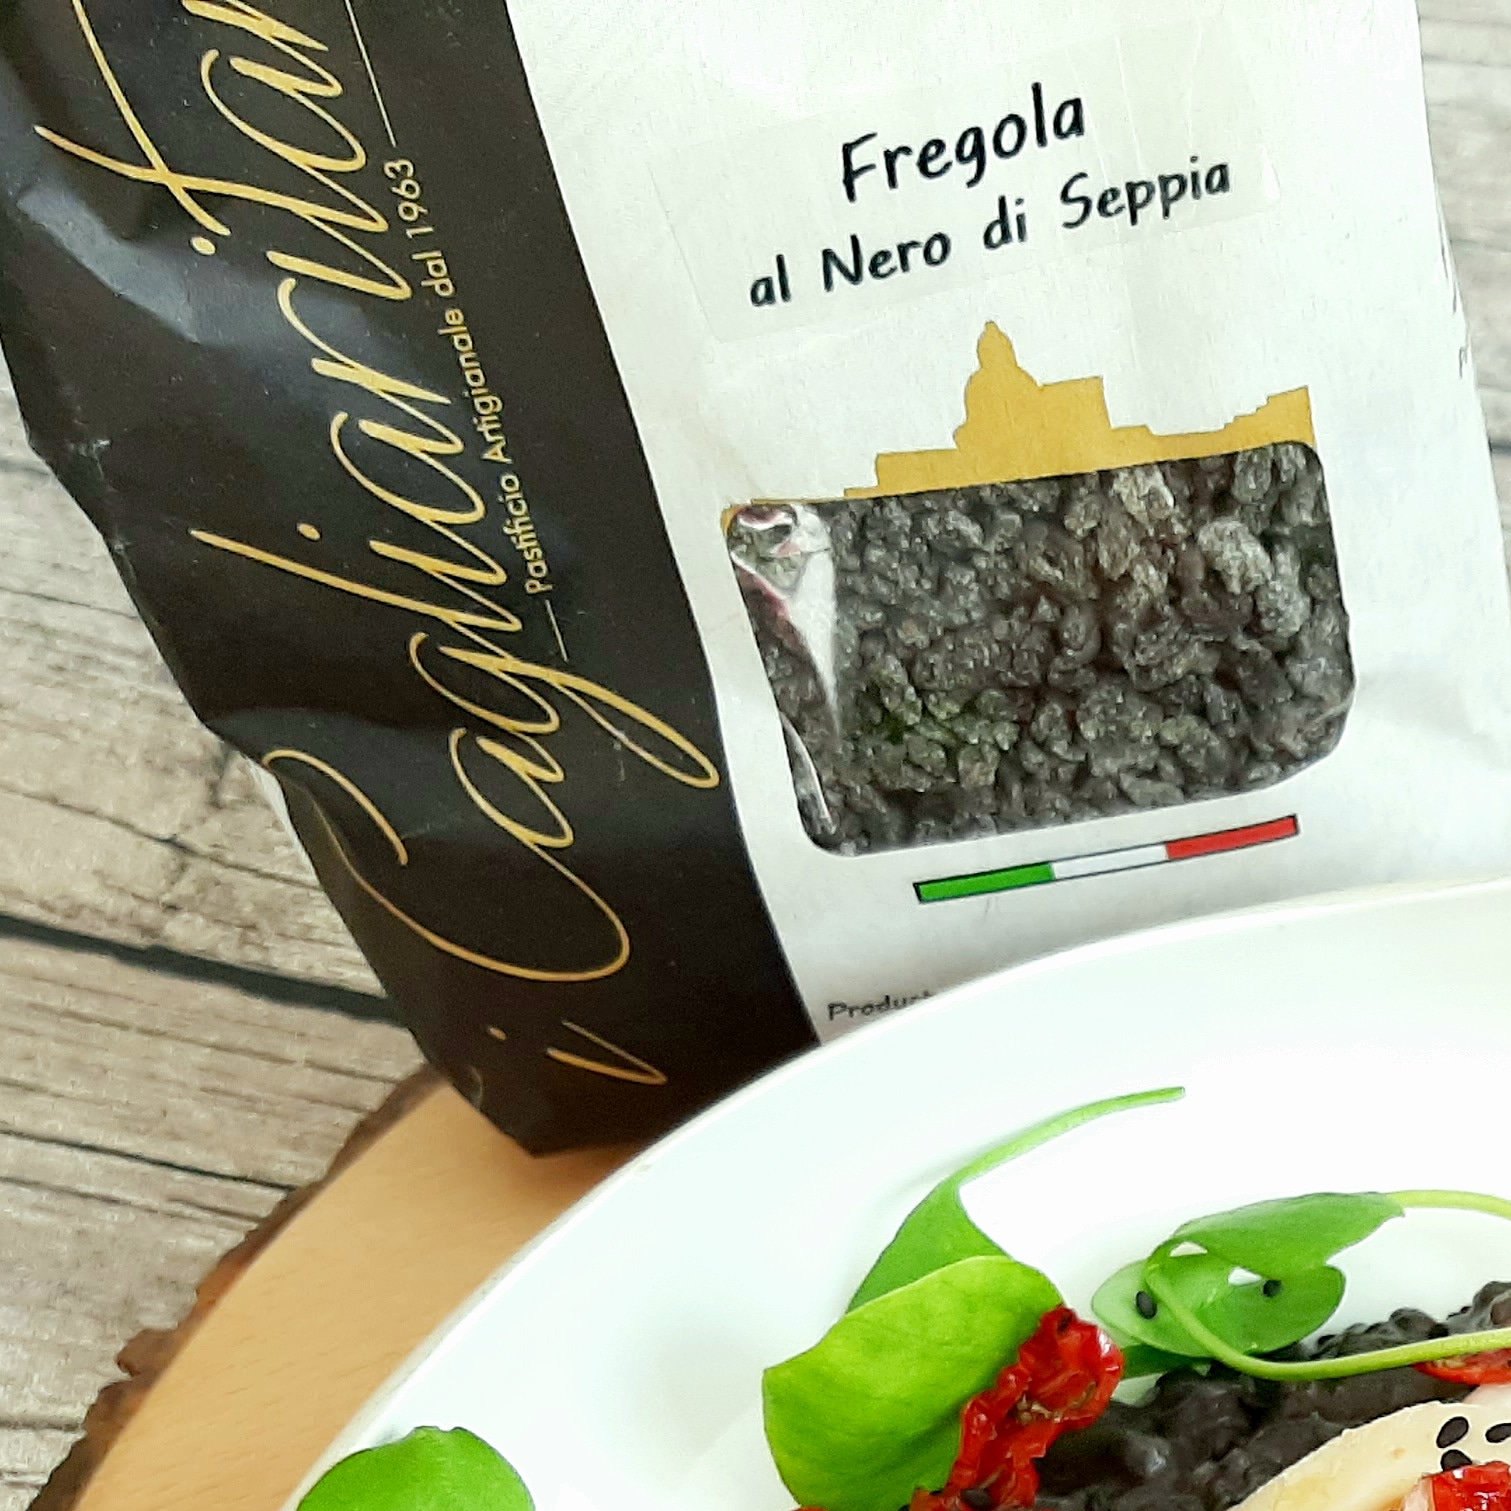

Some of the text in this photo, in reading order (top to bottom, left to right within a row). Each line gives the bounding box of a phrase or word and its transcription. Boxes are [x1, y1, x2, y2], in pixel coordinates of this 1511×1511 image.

[841, 82, 1085, 203] Fregola
[750, 156, 1230, 307] al Nero di Seppia
[383, 158, 554, 595] Pastificio Artigianale dal 1963
